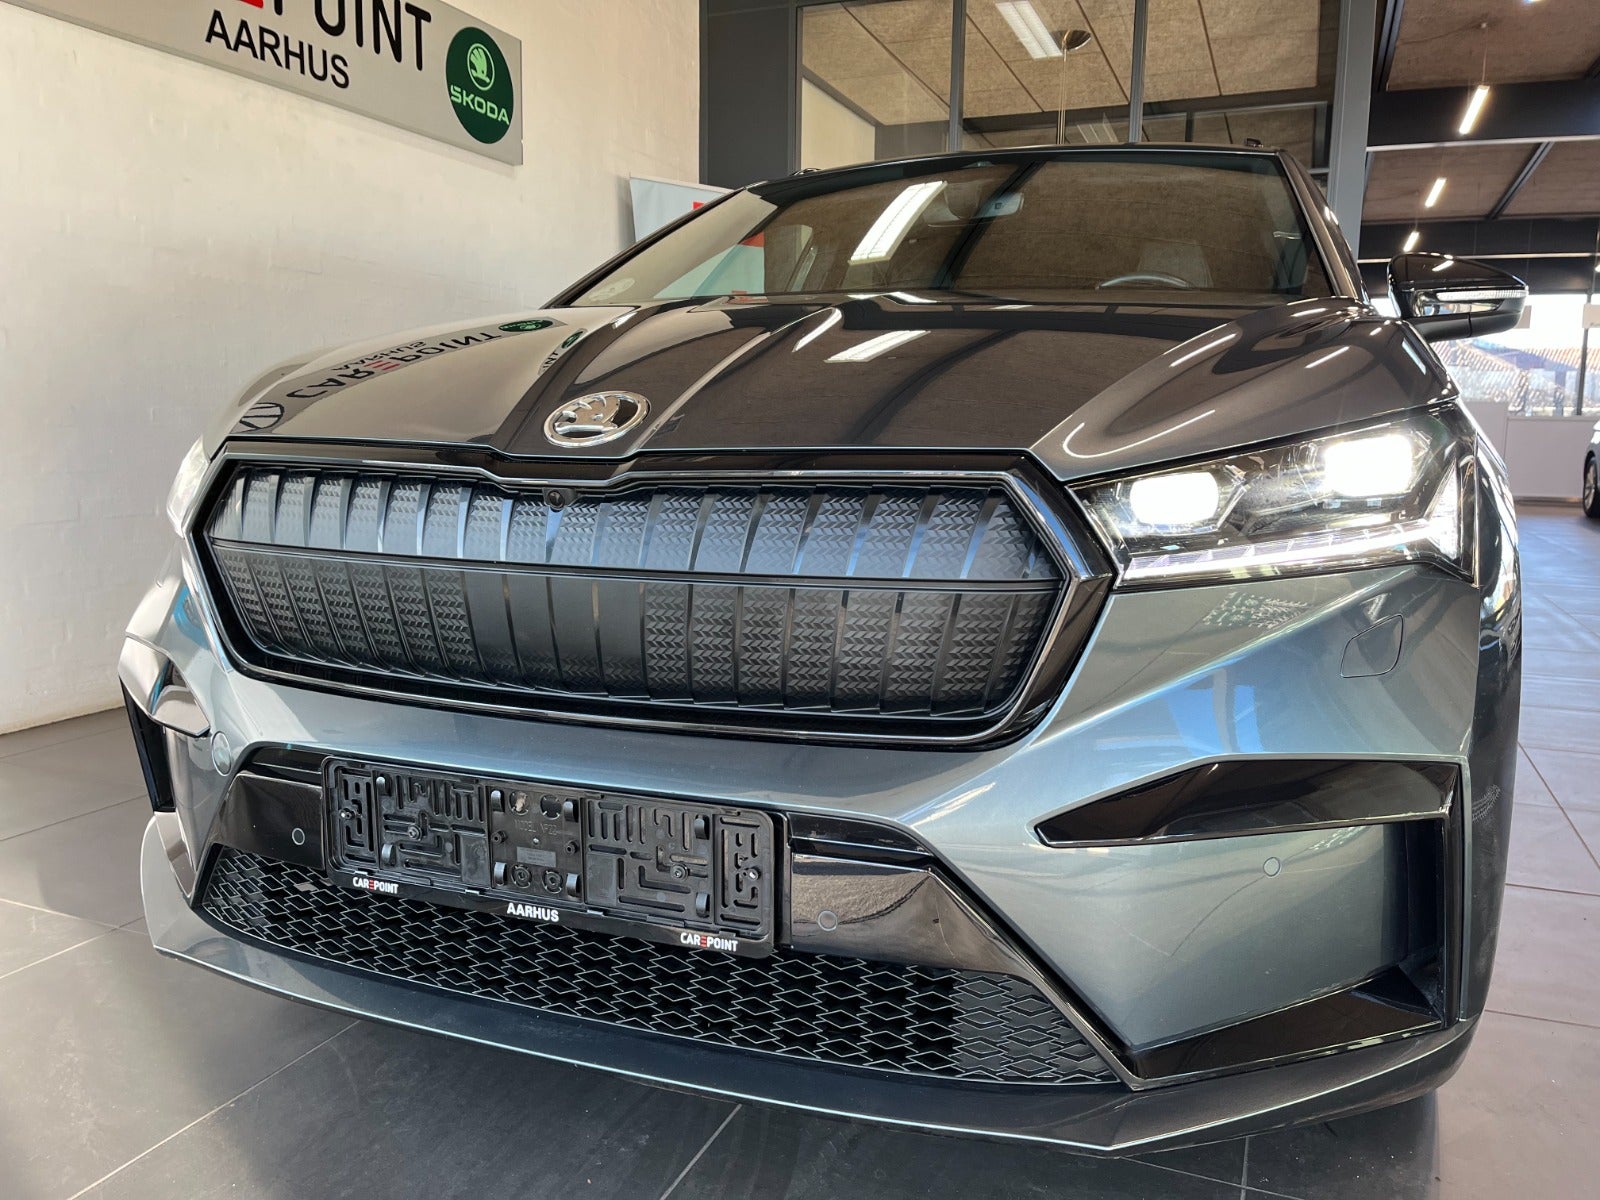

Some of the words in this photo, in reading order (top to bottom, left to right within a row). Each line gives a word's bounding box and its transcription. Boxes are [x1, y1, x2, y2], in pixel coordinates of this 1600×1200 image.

[205, 9, 349, 89] AARHUS
[450, 84, 510, 125] SKODA
[352, 877, 399, 894] CAREPOINT
[506, 902, 560, 922] AARHUS
[680, 931, 739, 952] CAREPOINT
